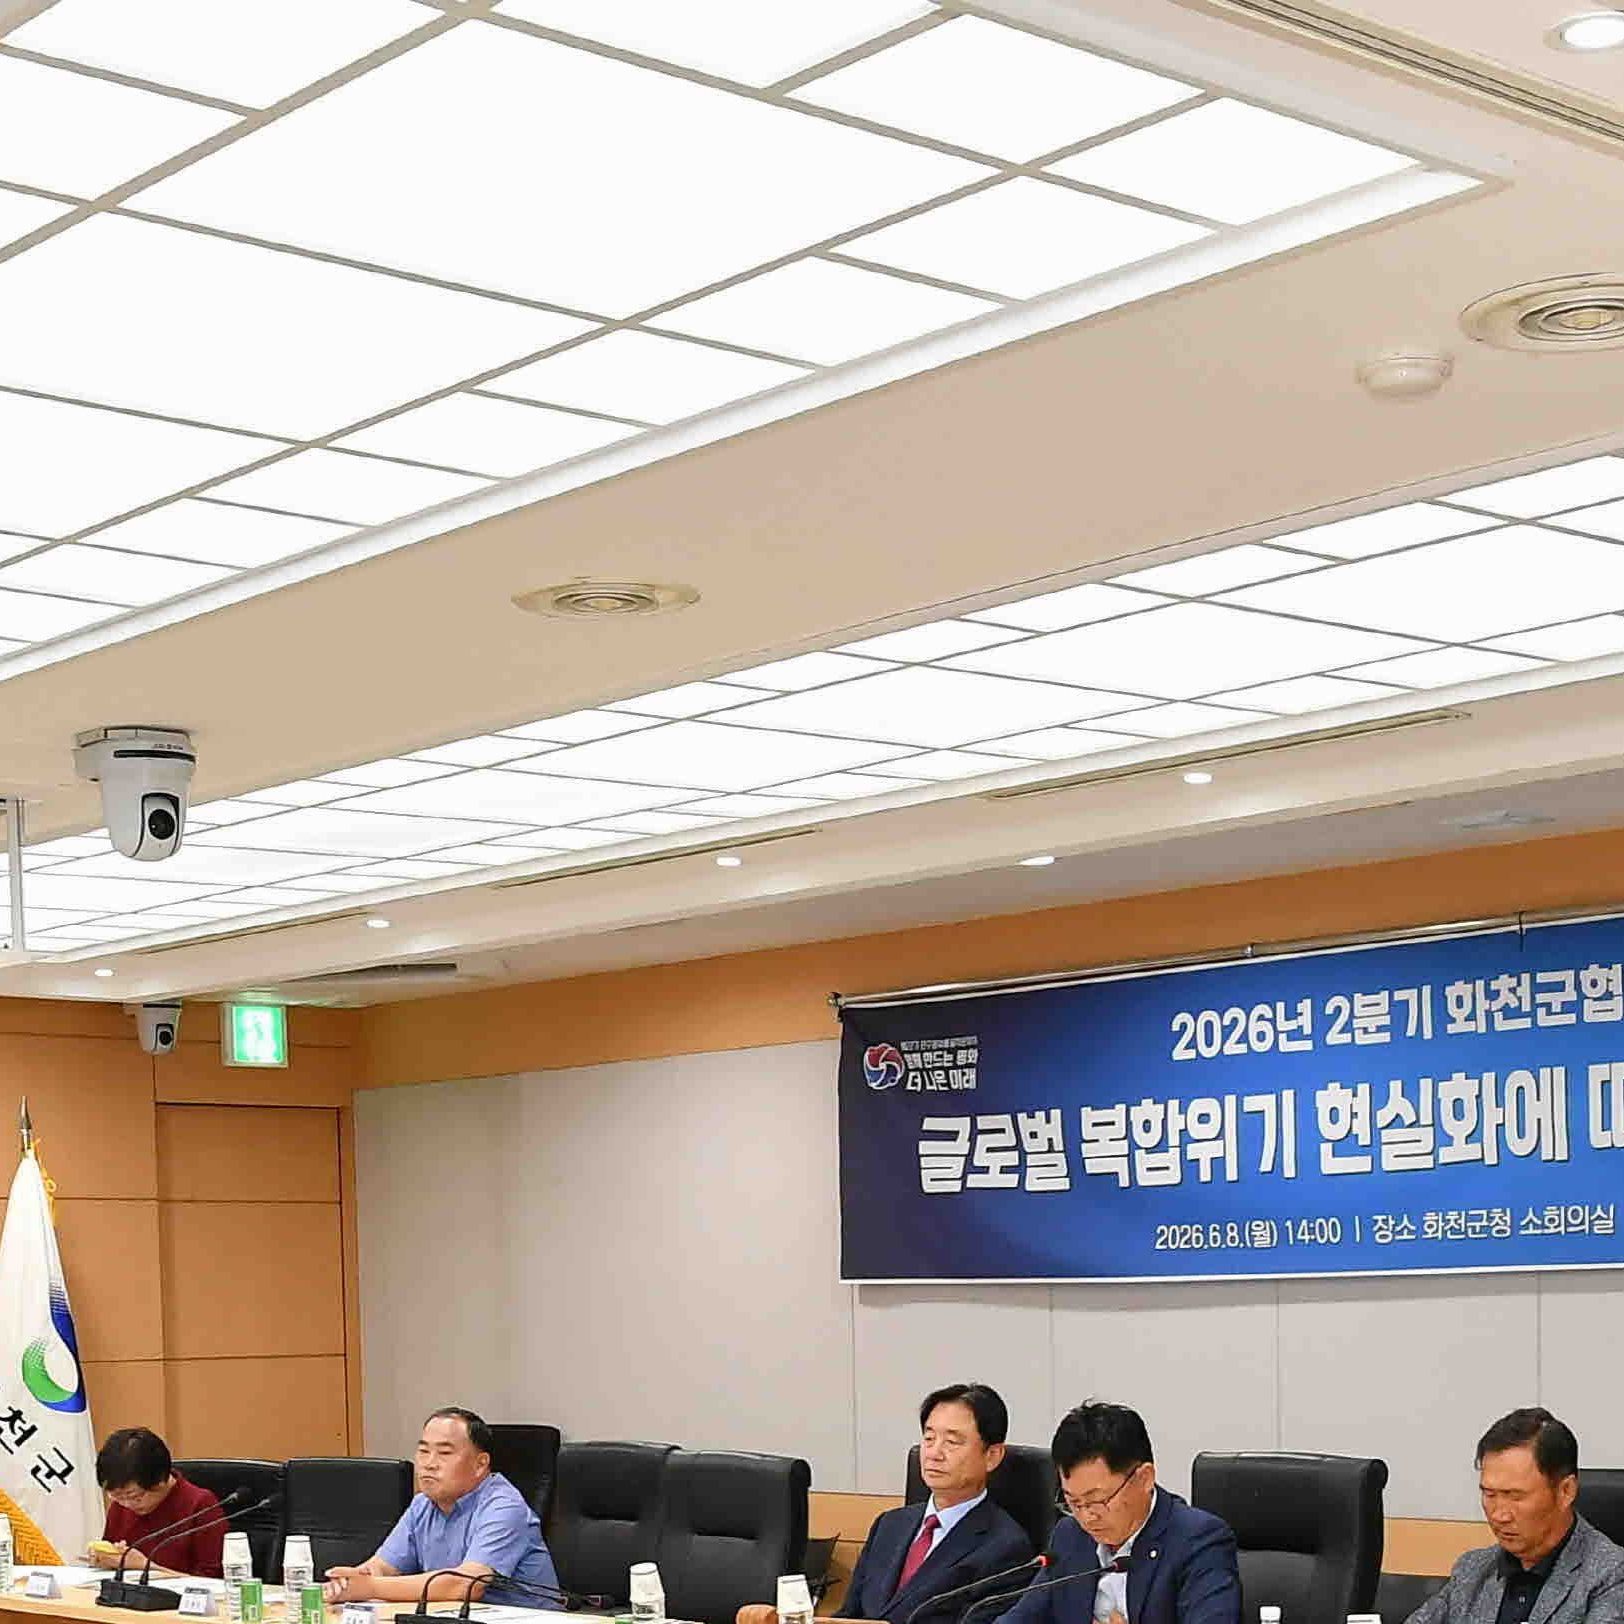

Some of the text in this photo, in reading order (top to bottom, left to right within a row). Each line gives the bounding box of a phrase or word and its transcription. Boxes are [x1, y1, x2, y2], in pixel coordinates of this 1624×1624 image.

[1171, 998, 1313, 1061] 2026년
[1325, 984, 1433, 1047] 2분기
[906, 1067, 976, 1092] 더 나은 미래
[918, 1108, 1071, 1194] 글로벌
[1080, 1089, 1296, 1189] 복합위기
[1315, 1065, 1570, 1177] 현실화에
[1154, 1203, 1616, 1251] 2026.6.8.(월) 14:00 장소 화천군청 소회의실
